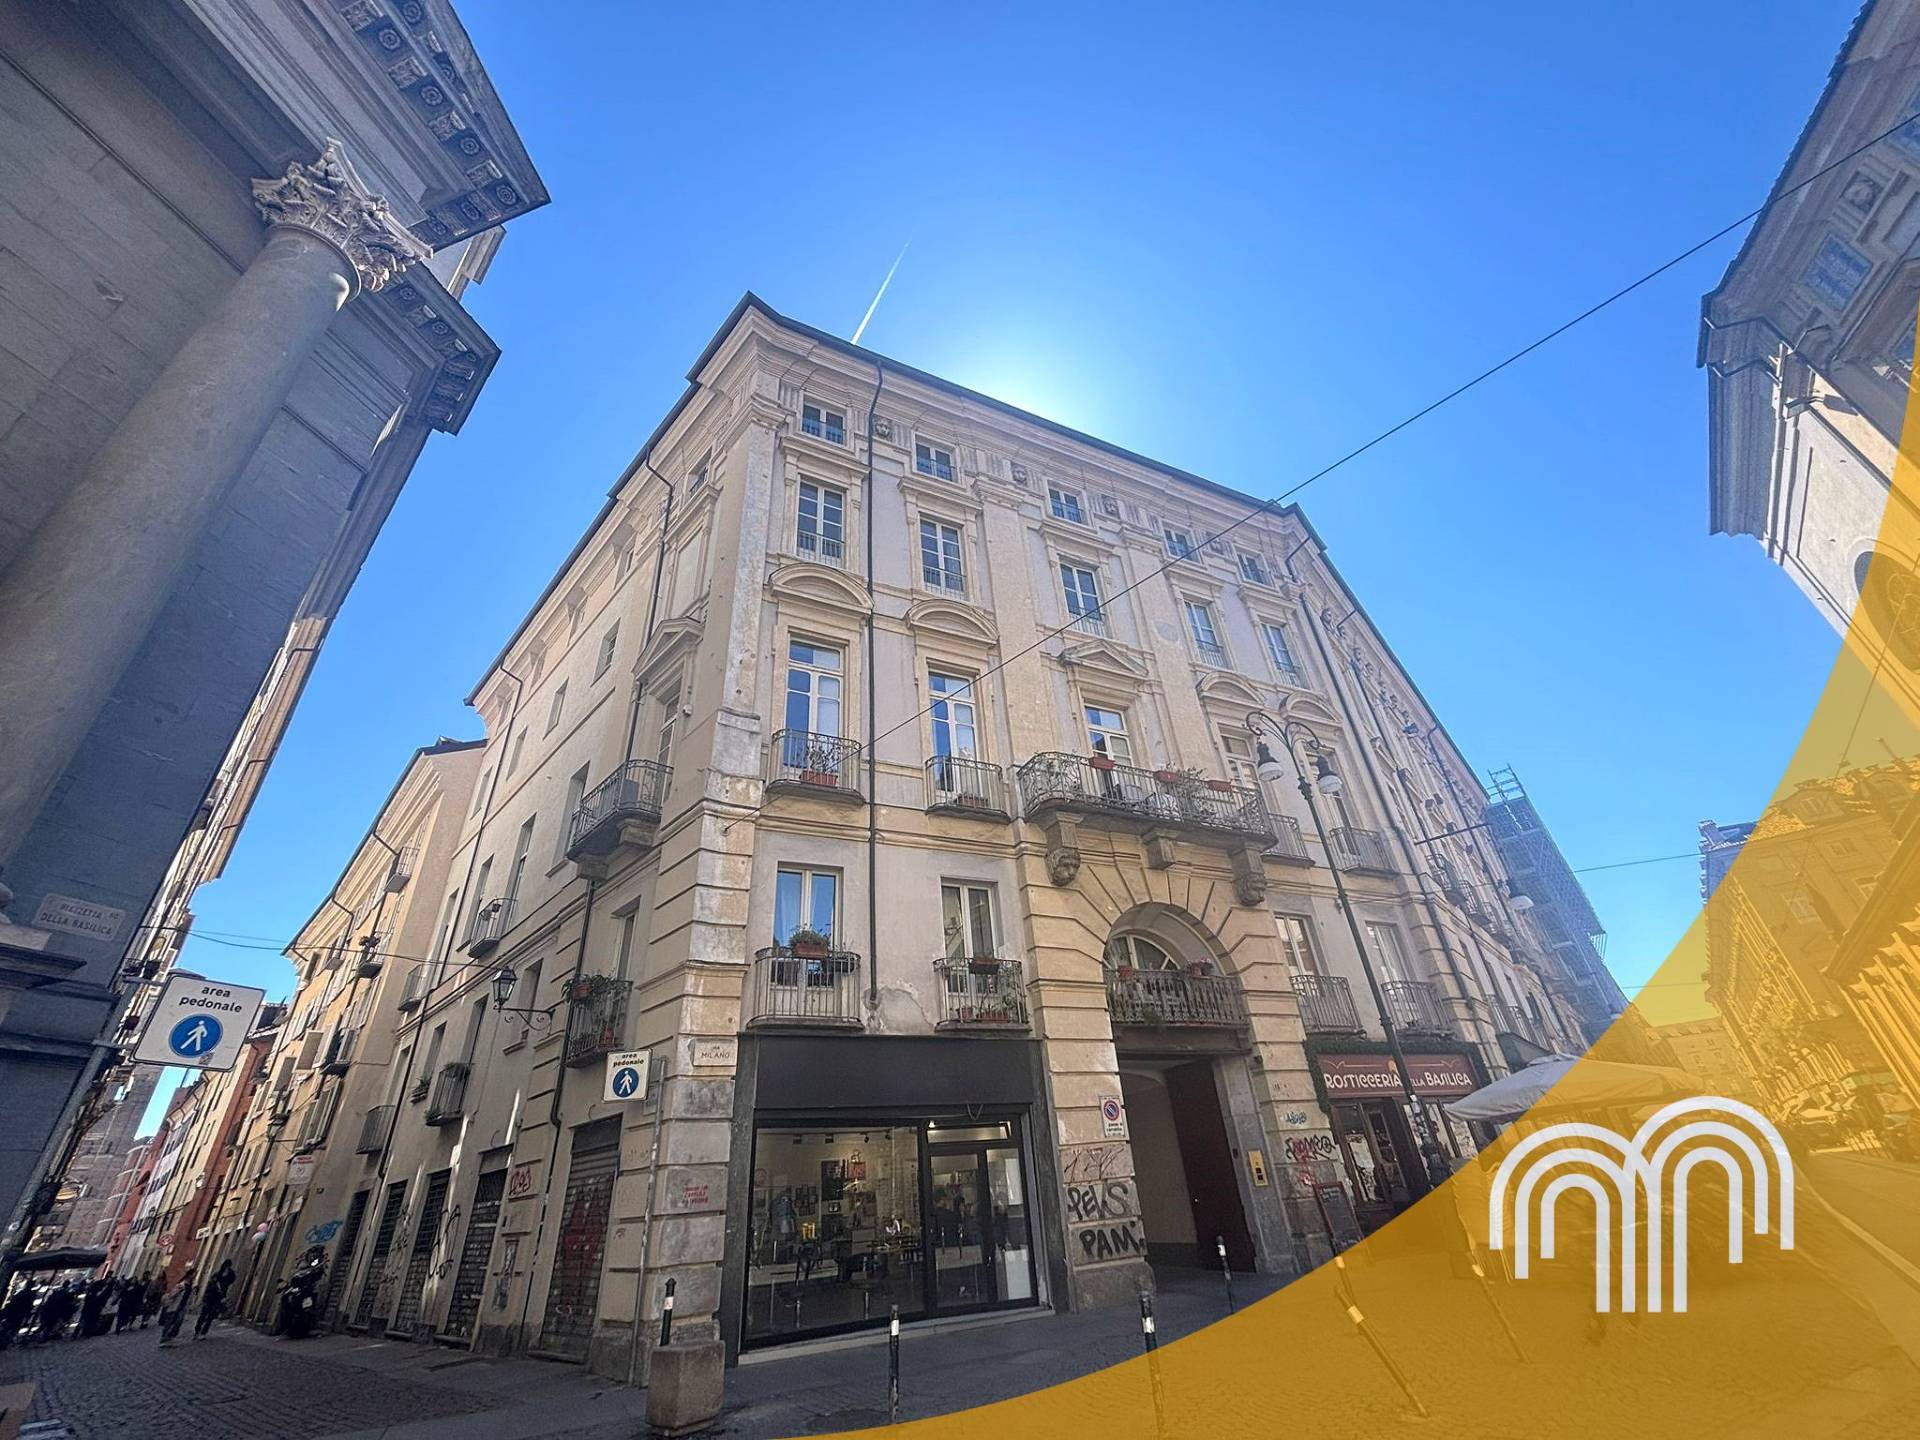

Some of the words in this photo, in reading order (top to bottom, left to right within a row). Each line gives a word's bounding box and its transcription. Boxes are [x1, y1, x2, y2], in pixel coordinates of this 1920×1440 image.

[40, 912, 69, 925] DELLA
[72, 919, 112, 935] BASILICA
[201, 986, 231, 998] area
[178, 996, 242, 1013] pedonale
[701, 1051, 730, 1059] MILANO
[613, 1058, 645, 1068] pedonale
[1323, 1072, 1402, 1089] ROSTICCERIA
[1424, 1071, 1473, 1087] BASILICA
